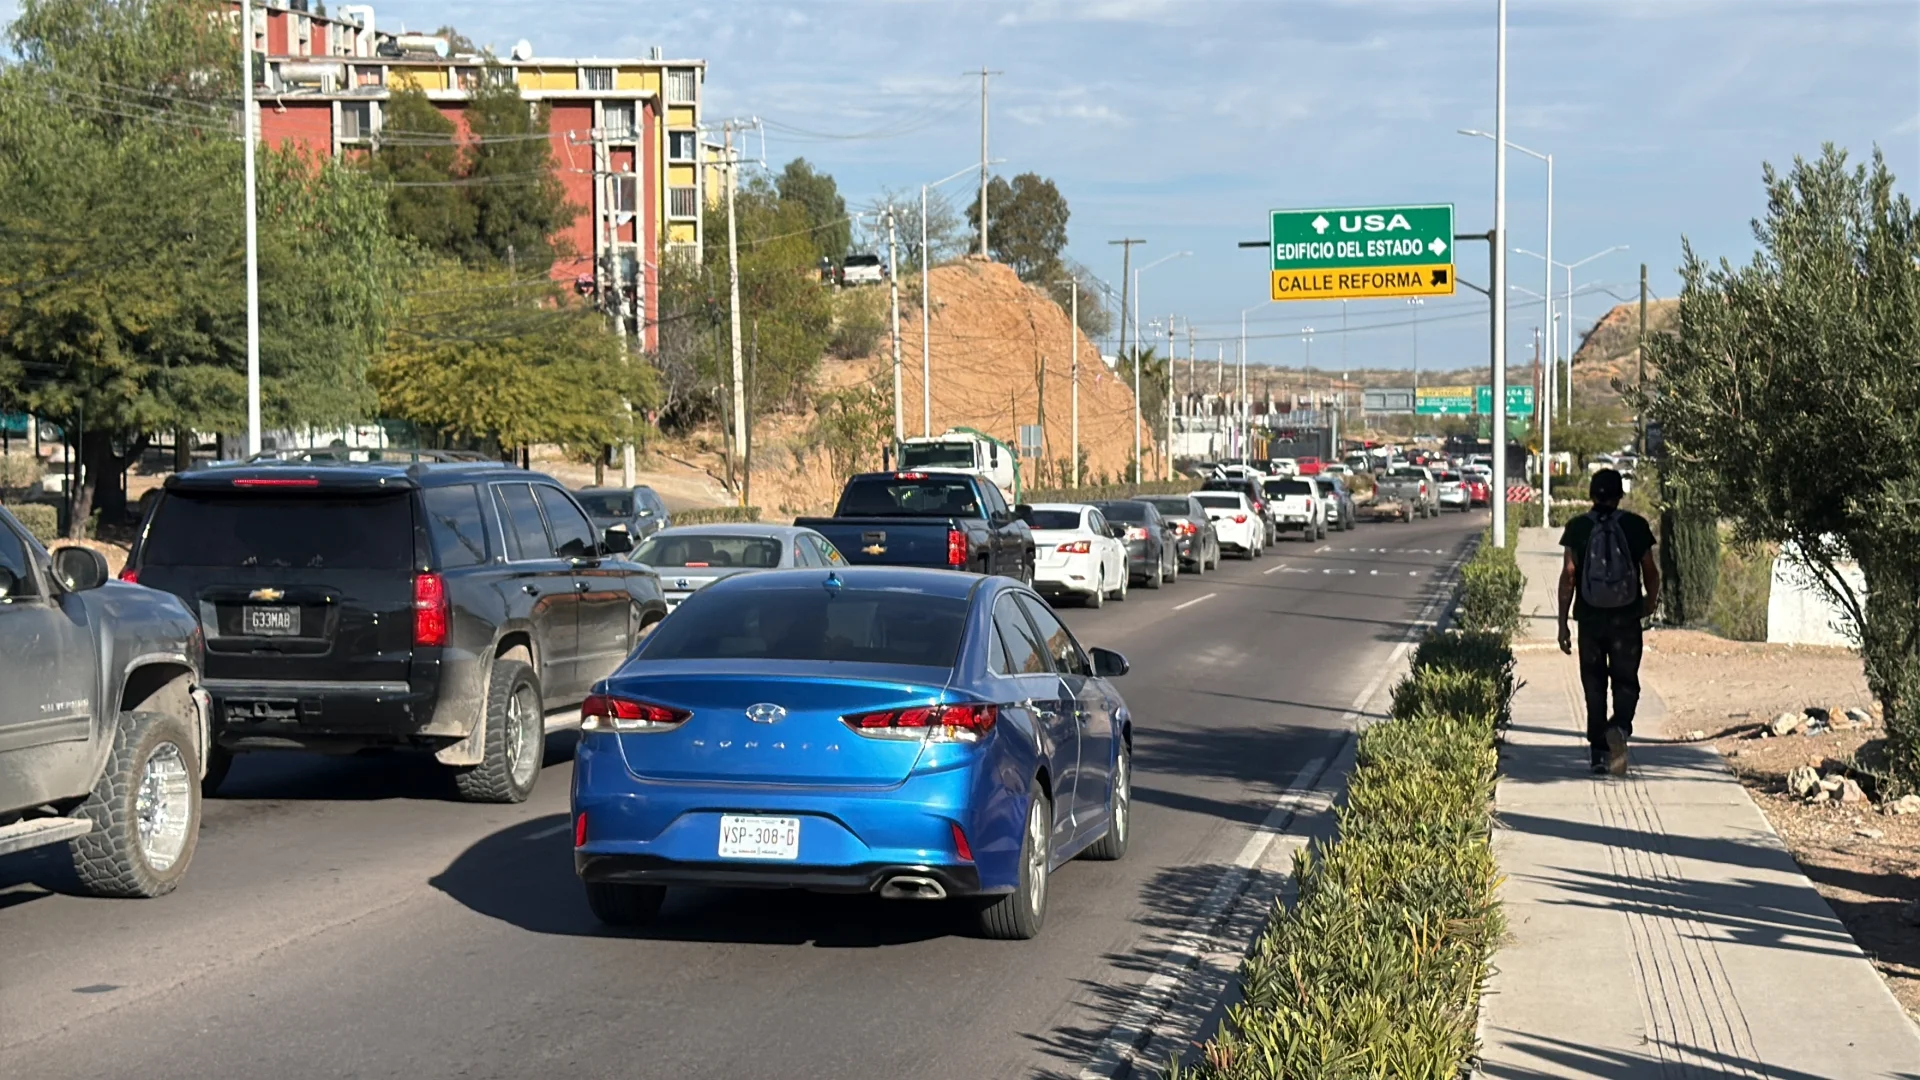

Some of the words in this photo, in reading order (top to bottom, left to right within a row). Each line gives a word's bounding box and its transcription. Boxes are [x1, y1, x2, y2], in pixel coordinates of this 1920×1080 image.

[1339, 213, 1412, 233] USA
[1276, 241, 1334, 260] EDIFICIO
[1337, 240, 1364, 258] DEL
[1367, 238, 1423, 257] ESTADO
[1278, 274, 1333, 292] CALLE
[1338, 271, 1423, 290] REFORMA
